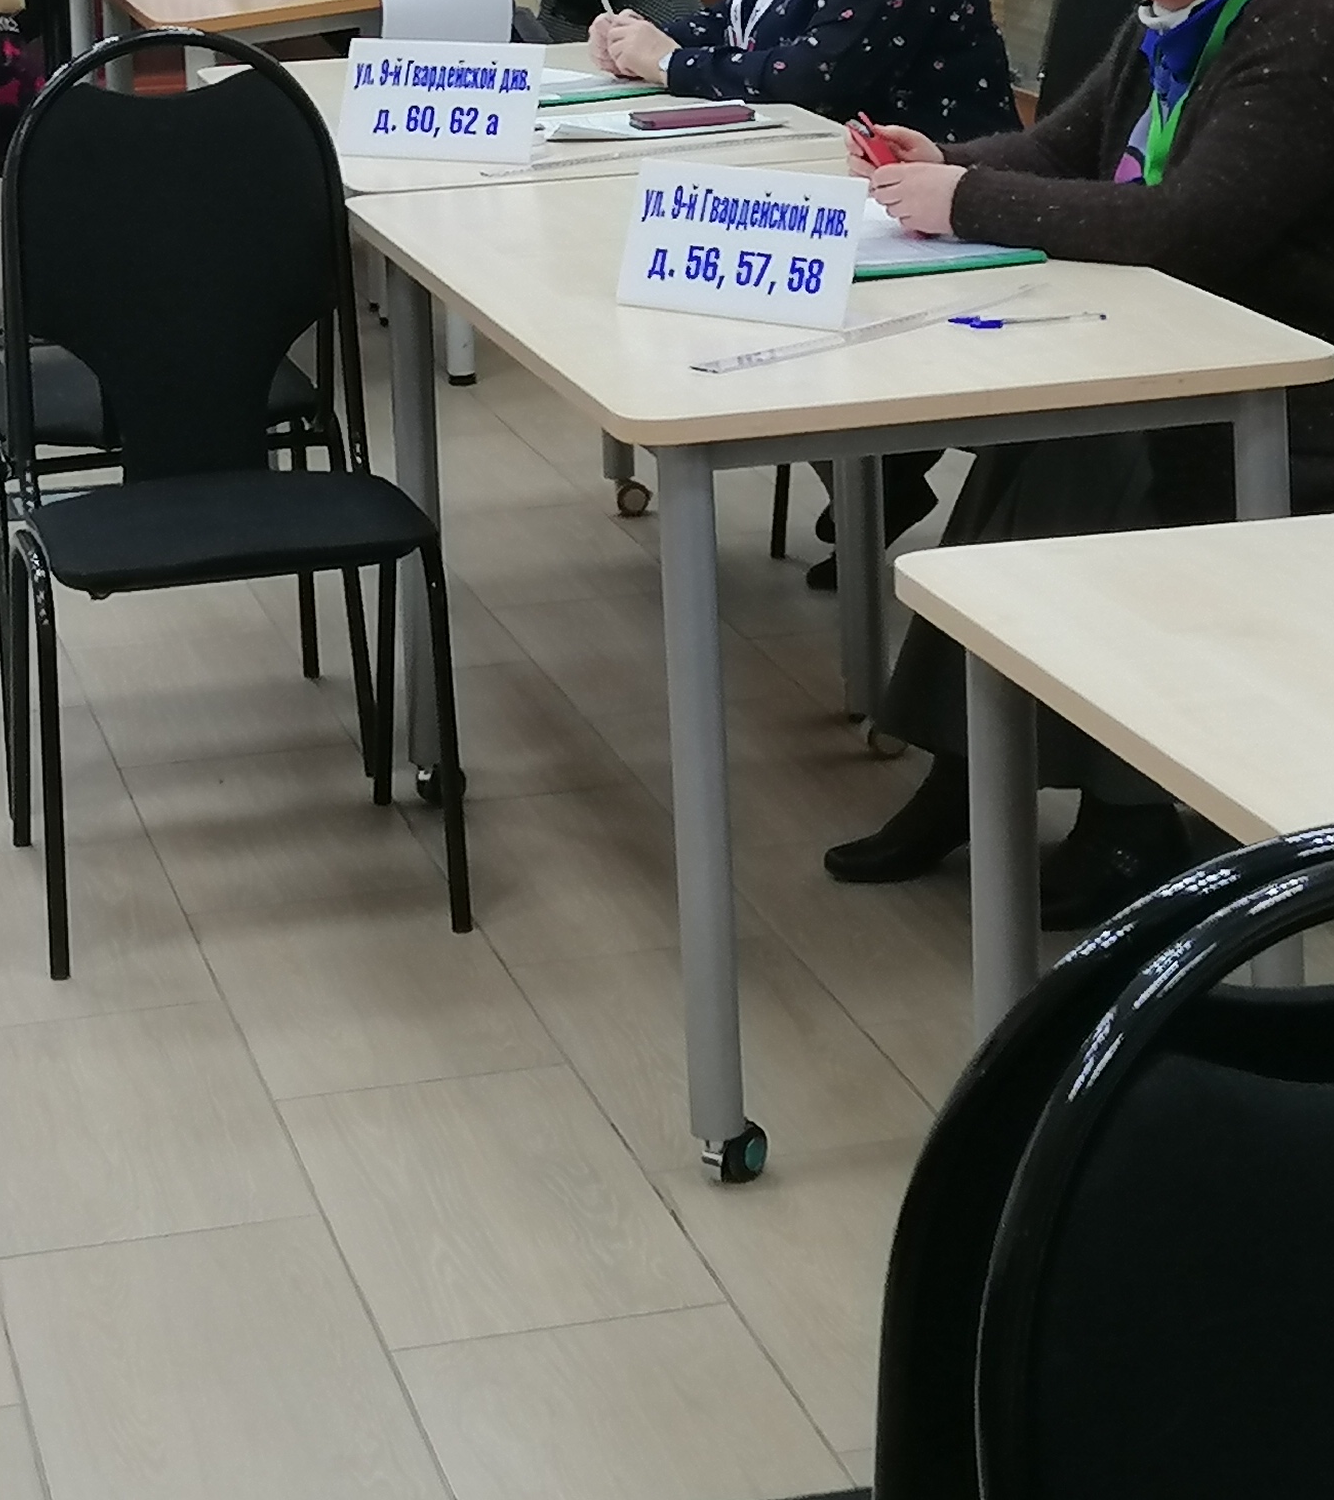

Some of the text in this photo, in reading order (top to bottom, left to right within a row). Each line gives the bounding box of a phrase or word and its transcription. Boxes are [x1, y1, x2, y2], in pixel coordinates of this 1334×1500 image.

[354, 57, 531, 93] ул. 9-й Гвардейской див.
[373, 105, 499, 138] д. 60, 62 а
[641, 183, 849, 238] ул. 9-й Гвардейской див.
[647, 245, 825, 295] д. 56, 57, 58
